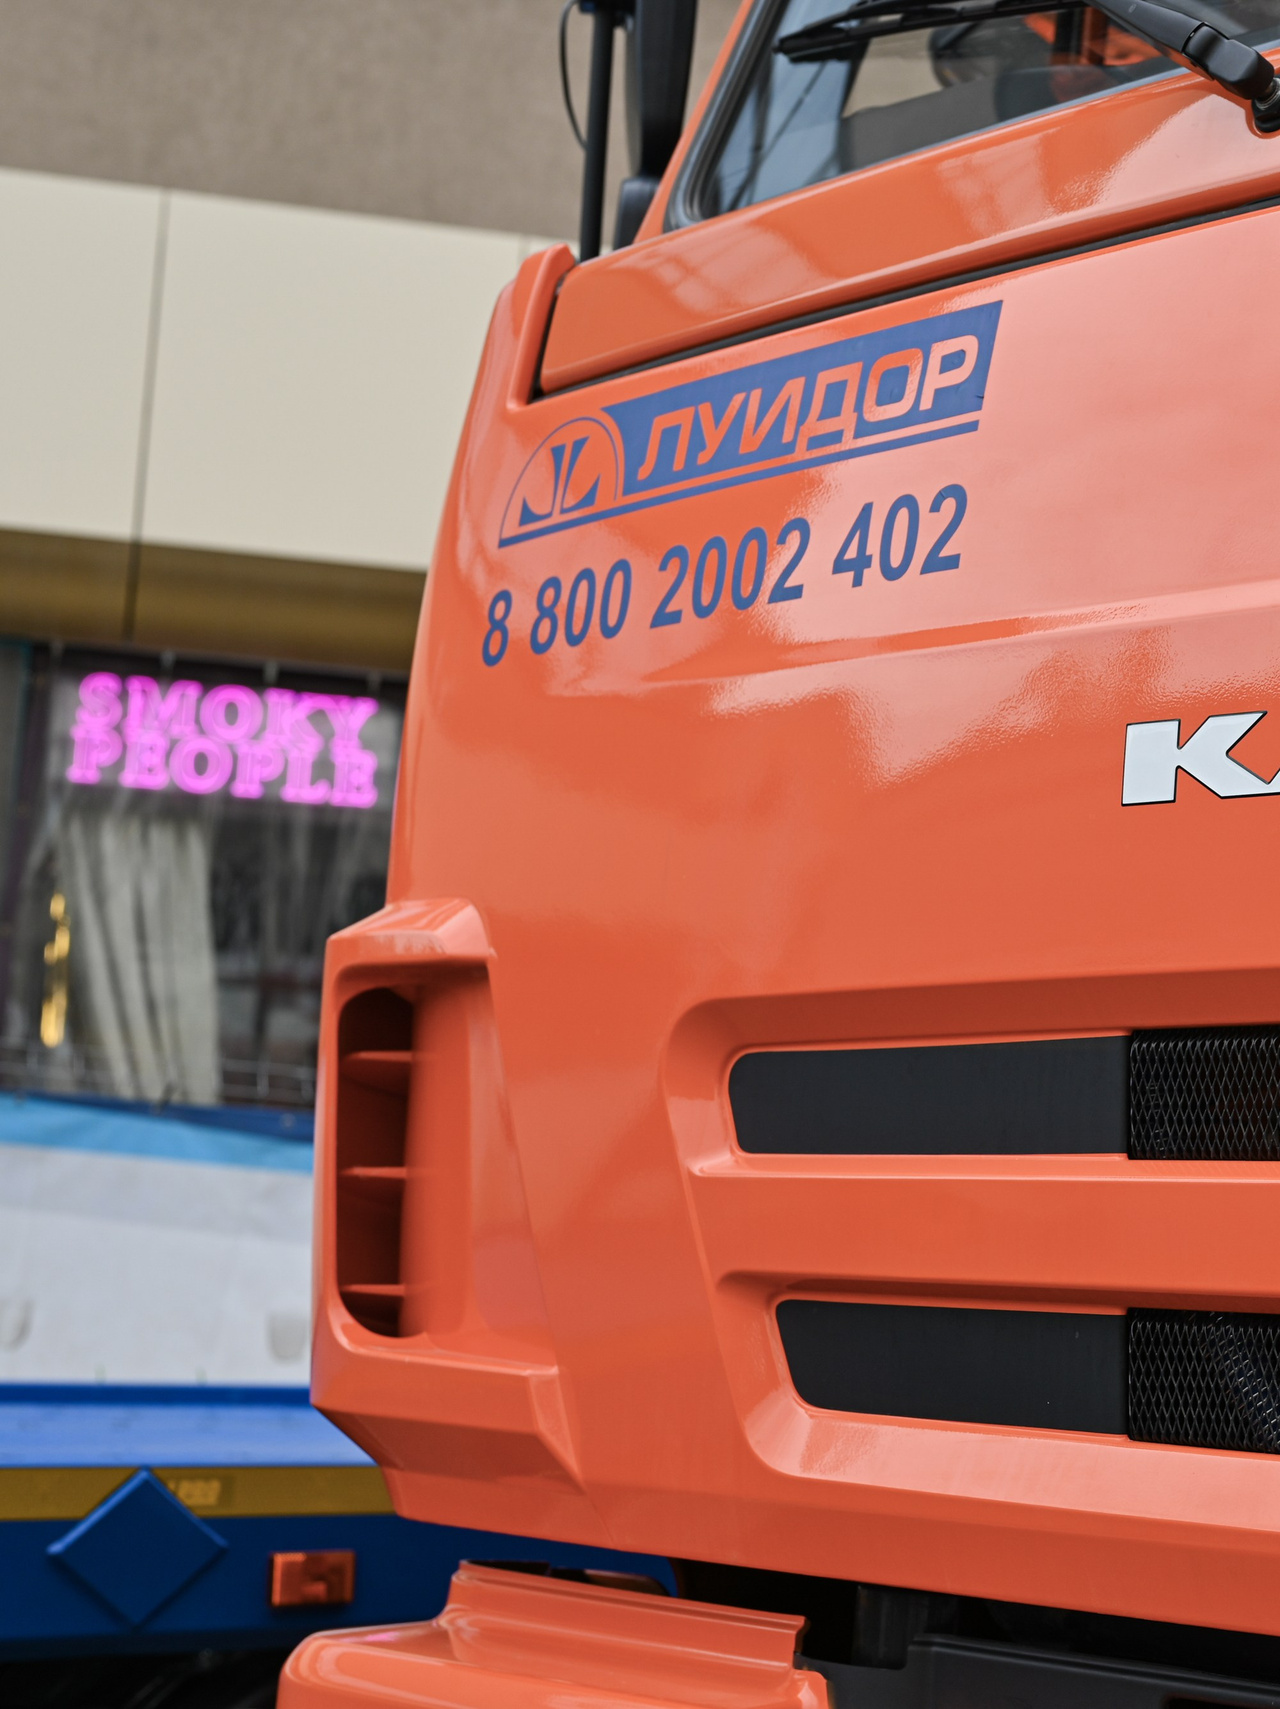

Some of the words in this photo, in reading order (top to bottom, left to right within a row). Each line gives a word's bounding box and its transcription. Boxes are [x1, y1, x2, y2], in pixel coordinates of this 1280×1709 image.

[637, 334, 980, 481] ЛУИДОР
[481, 589, 513, 667] 8
[529, 559, 632, 655] 800
[649, 517, 811, 629] 2002
[831, 483, 968, 588] 402
[66, 724, 379, 809] PEOPLE
[74, 671, 379, 756] SMOKY
